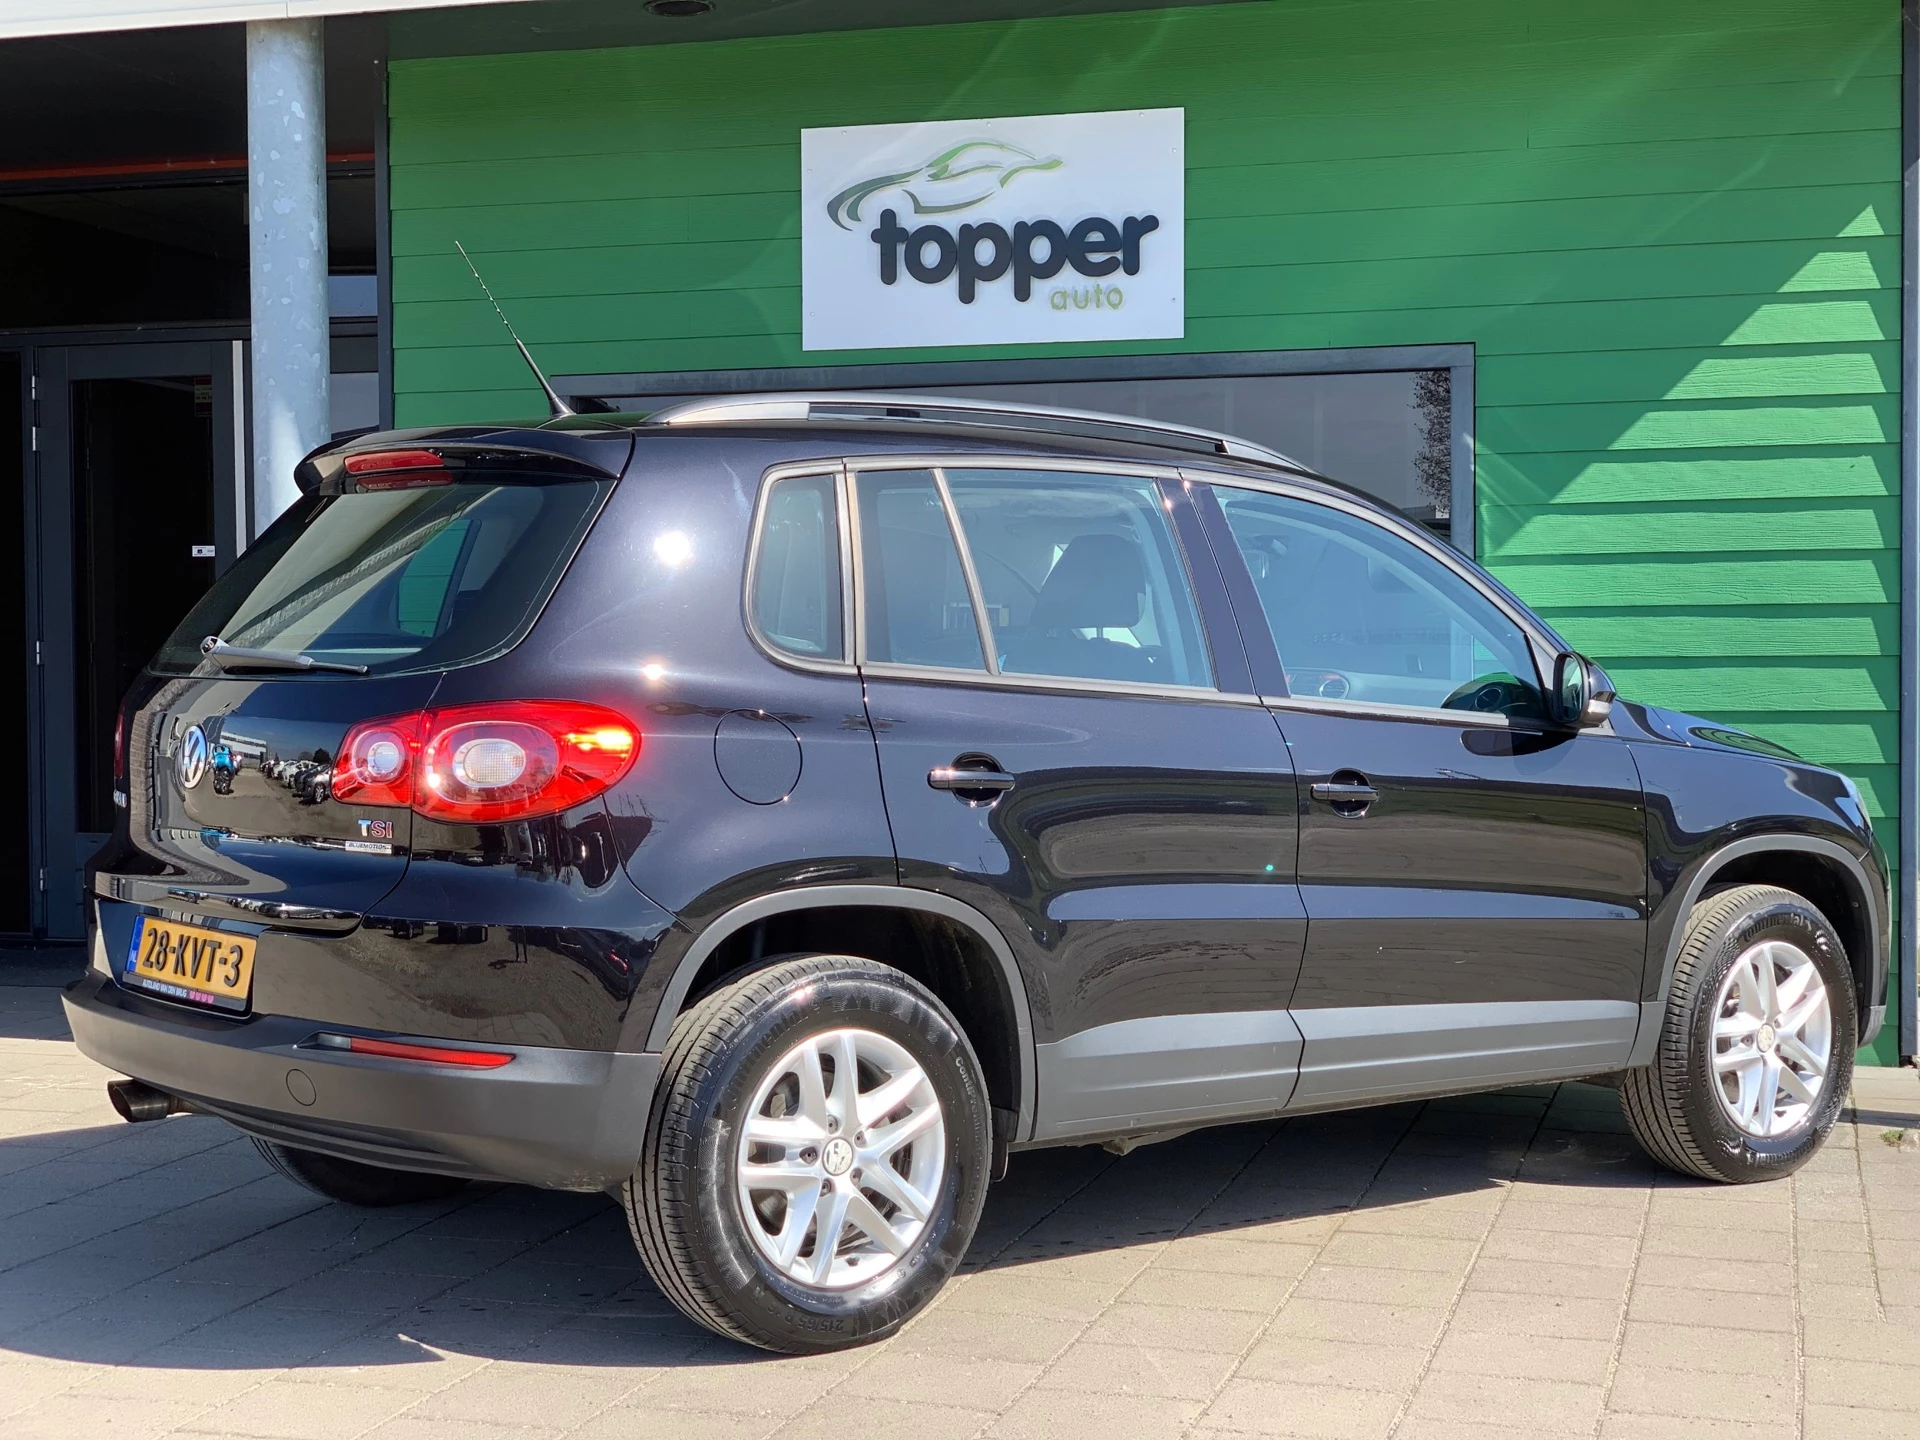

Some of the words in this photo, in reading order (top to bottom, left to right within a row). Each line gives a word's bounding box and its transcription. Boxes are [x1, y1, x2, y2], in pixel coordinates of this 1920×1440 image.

[871, 209, 1159, 304] topper
[1050, 284, 1124, 310] auto
[358, 819, 393, 838] TSI
[142, 927, 244, 988] 28-KVT-3
